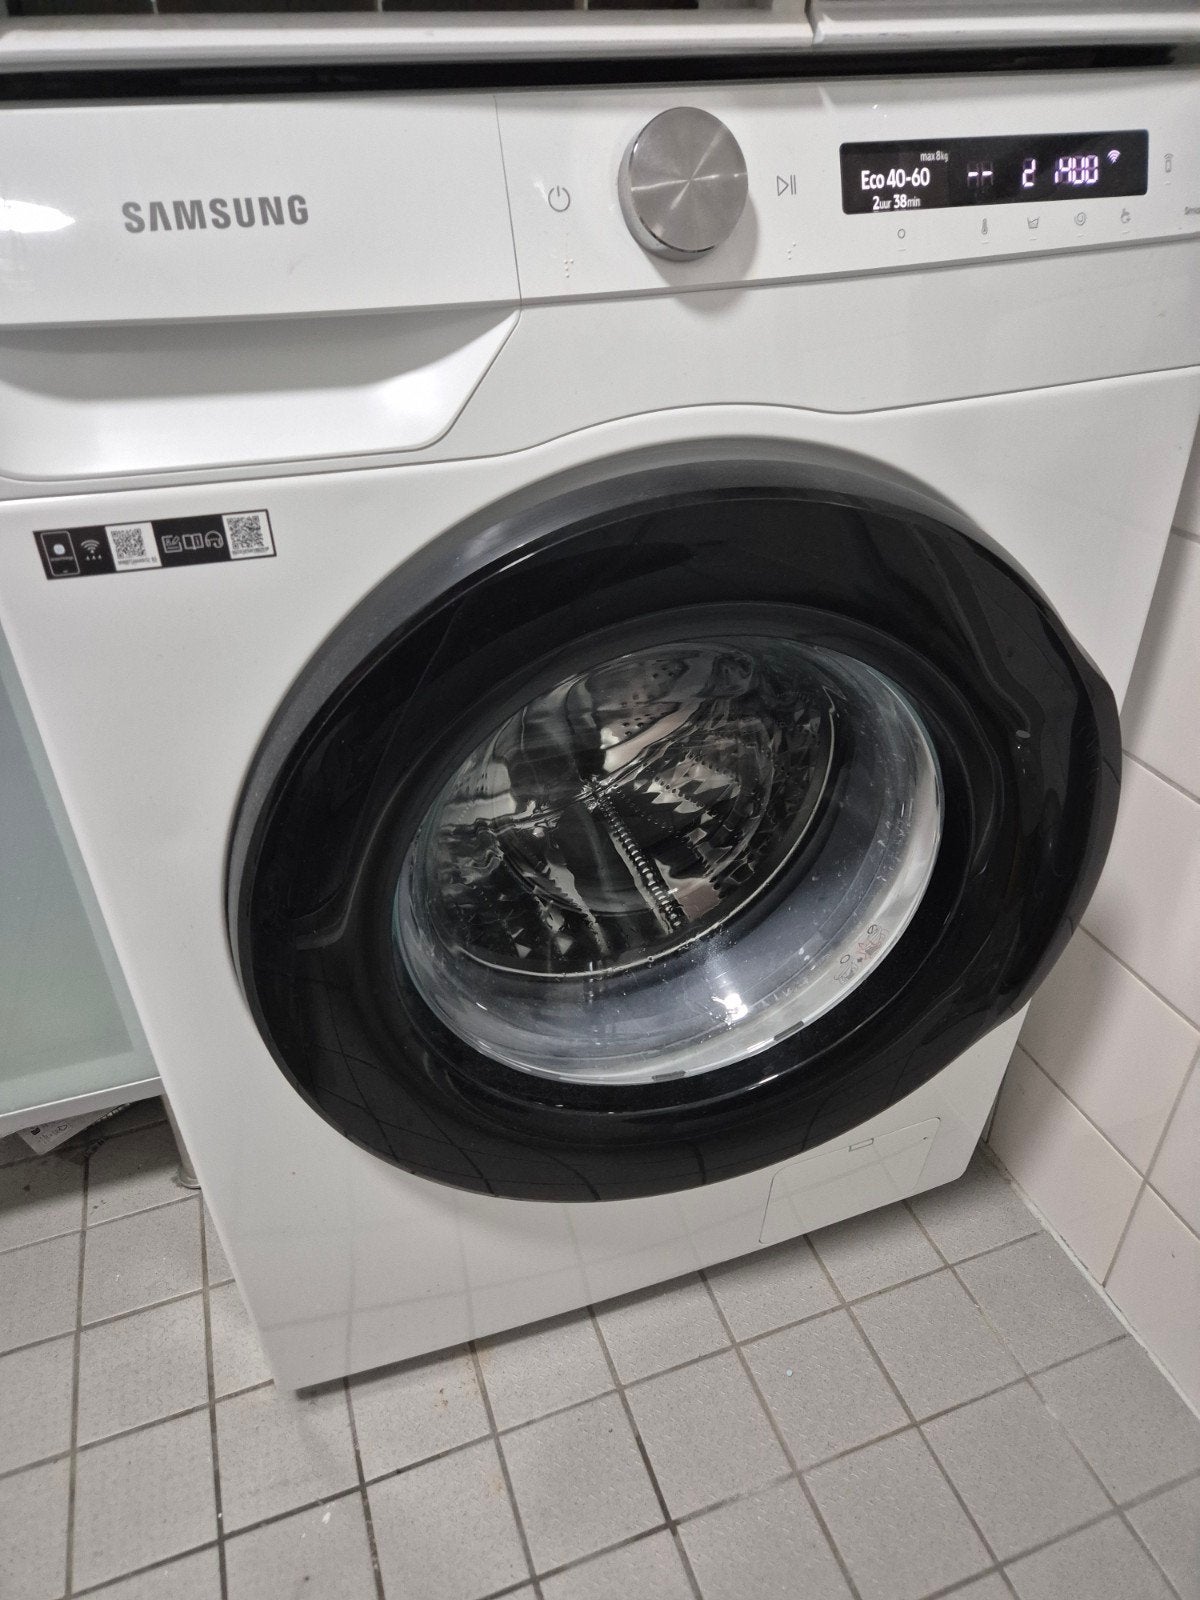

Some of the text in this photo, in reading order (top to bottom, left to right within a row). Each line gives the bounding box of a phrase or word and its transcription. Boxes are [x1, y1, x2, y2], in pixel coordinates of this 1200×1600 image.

[861, 167, 930, 190] Eco 40-60
[1022, 158, 1036, 188] 2
[1054, 155, 1099, 184] 1400
[121, 194, 309, 234] SAMSUNG
